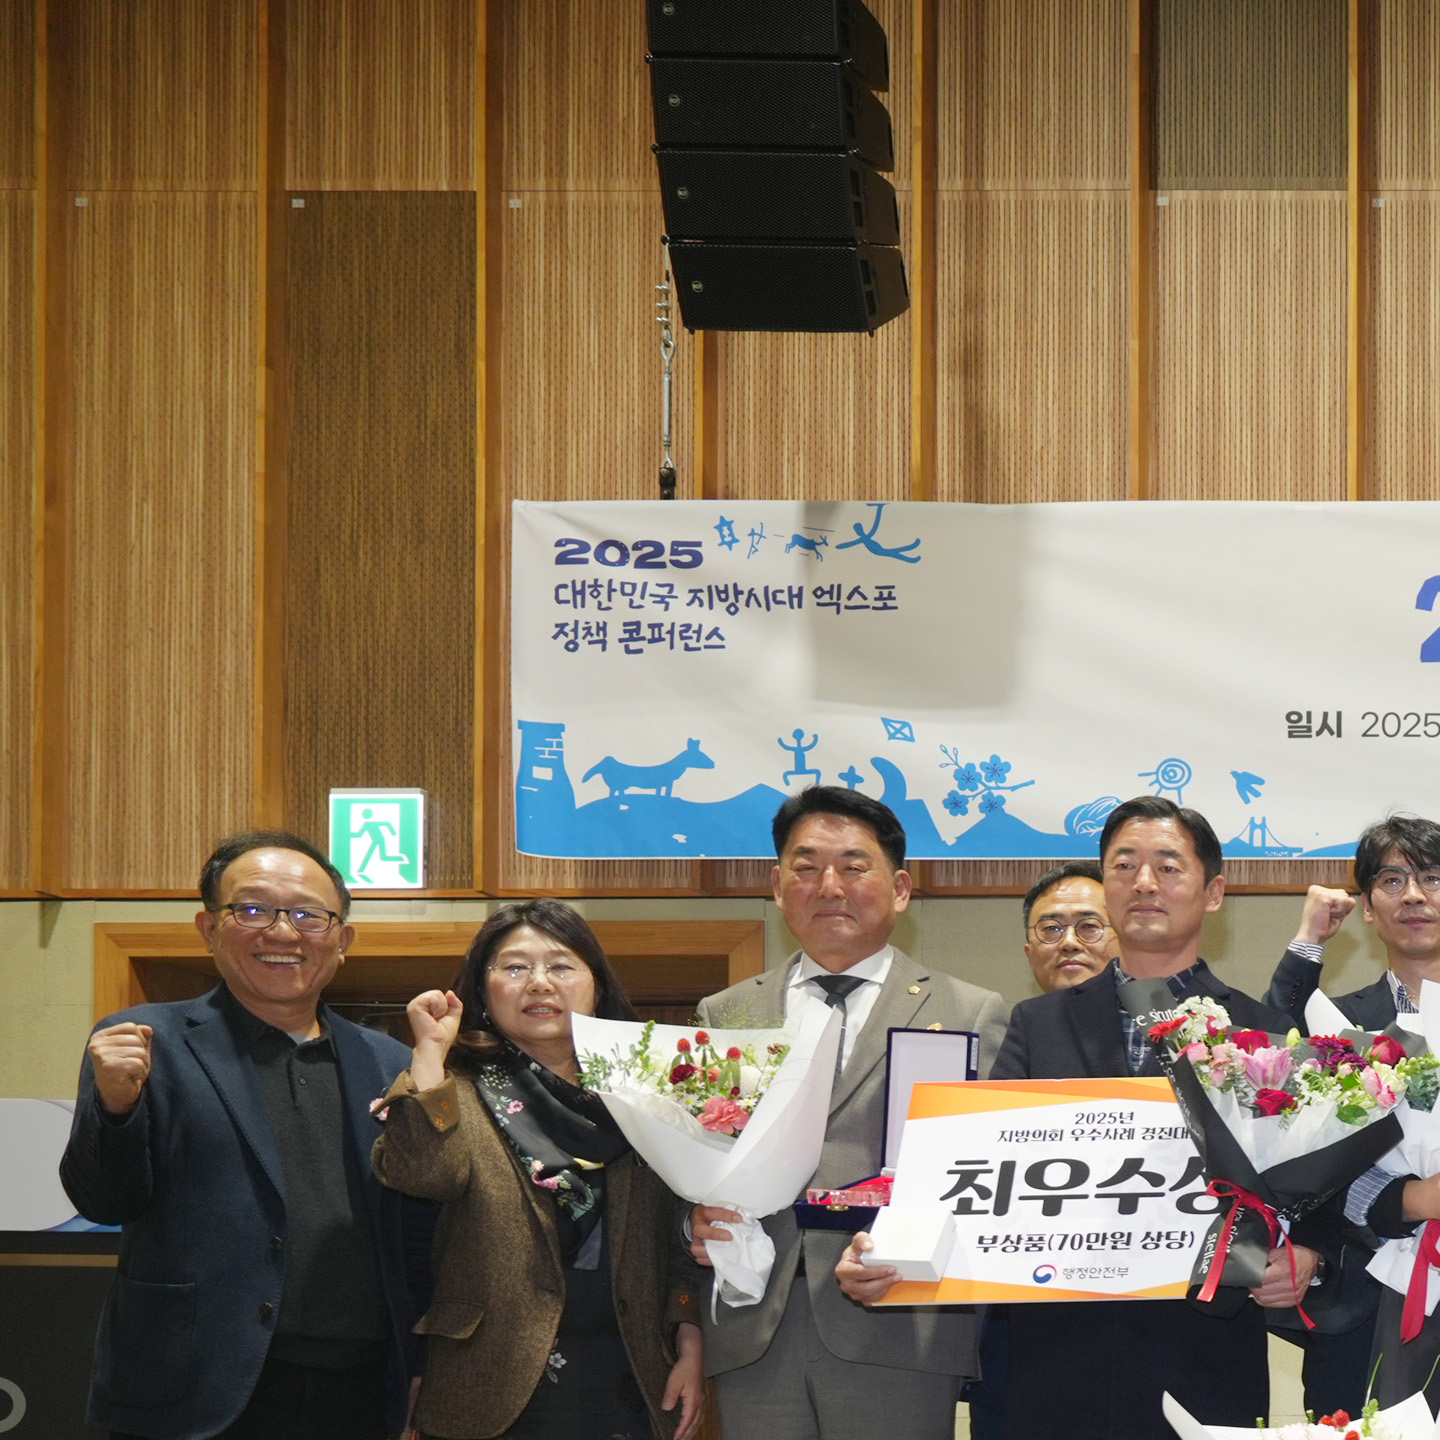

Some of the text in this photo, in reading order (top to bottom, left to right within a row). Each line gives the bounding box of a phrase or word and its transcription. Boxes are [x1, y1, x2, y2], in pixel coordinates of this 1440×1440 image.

[554, 538, 703, 569] 2025
[554, 579, 899, 616] 대한민국 지방시대 엑스포
[552, 620, 726, 655] 정책 콘퍼런스
[1285, 710, 1343, 739] 일시
[1075, 1111, 1134, 1126] 2025년
[996, 1126, 1193, 1143] 지방의회 우수사례 경진대
[976, 1230, 1195, 1254] 부상품(70만원 상당)
[1062, 1265, 1129, 1280] 행정안전부
